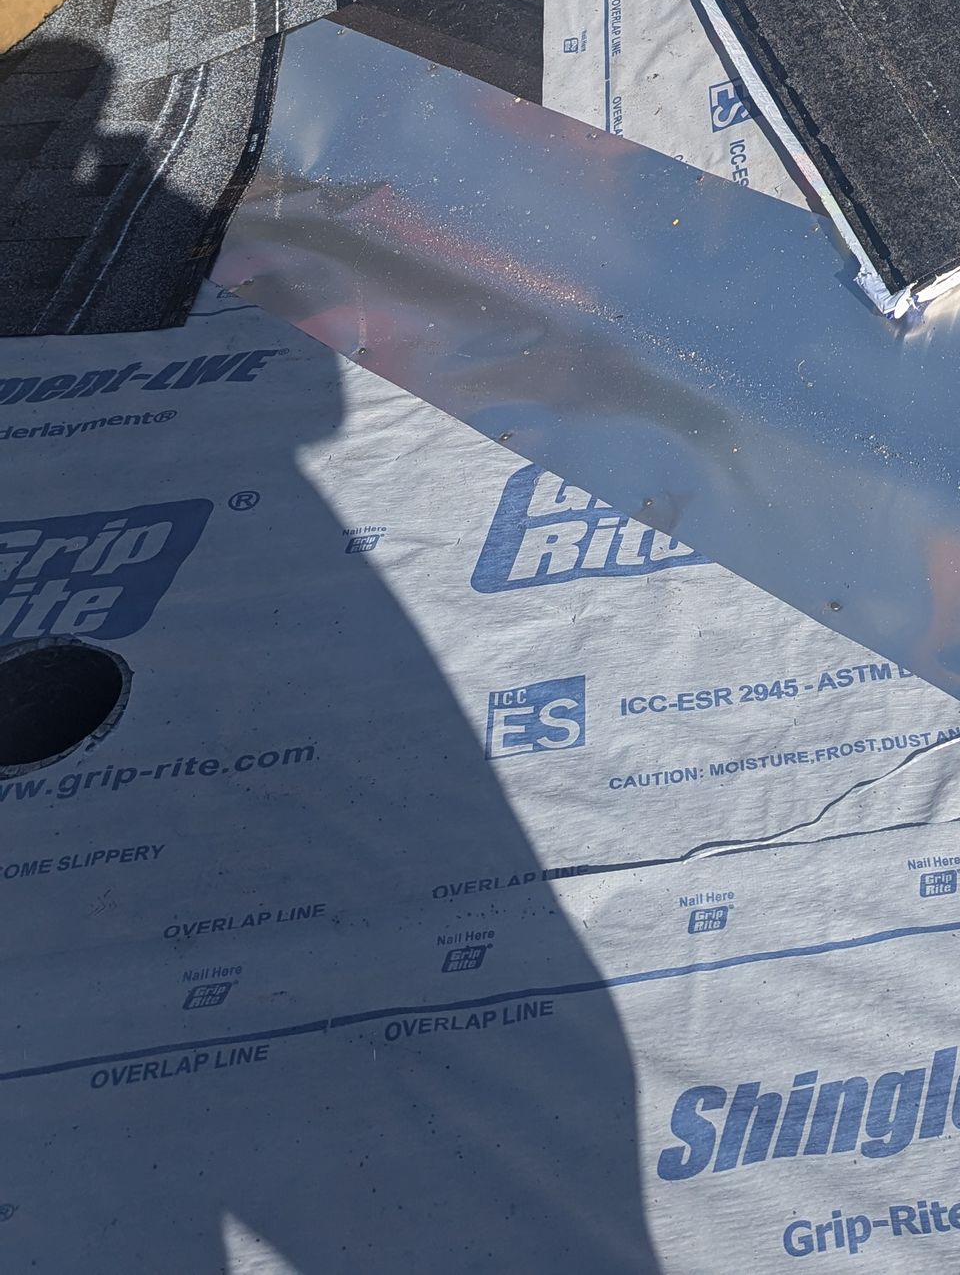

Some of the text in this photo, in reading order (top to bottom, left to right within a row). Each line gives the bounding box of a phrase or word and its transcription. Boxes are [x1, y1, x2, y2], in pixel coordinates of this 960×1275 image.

[612, 36, 621, 57] LINE
[343, 528, 362, 536] Nail
[493, 689, 528, 708] ICC
[619, 686, 734, 718] ICC-ESR
[738, 678, 800, 704] 2945
[816, 662, 893, 693] ASTM
[491, 697, 582, 754] ES
[607, 765, 705, 791] CAUTION:
[56, 844, 166, 873] SLIPPERY
[907, 857, 931, 872] Nail
[431, 870, 536, 900] OVERLAP
[925, 870, 957, 883] Grip
[679, 888, 736, 908] Nail Here
[923, 881, 956, 896] Rite
[163, 903, 327, 940] OVERLAP LINE
[692, 907, 727, 921] Grip
[688, 919, 723, 934] Rite
[435, 928, 496, 947] Nail Here
[182, 963, 243, 983] Nail Here
[383, 1000, 555, 1043] OVERLAP LINE
[89, 1043, 270, 1090] OVERLAP LINE
